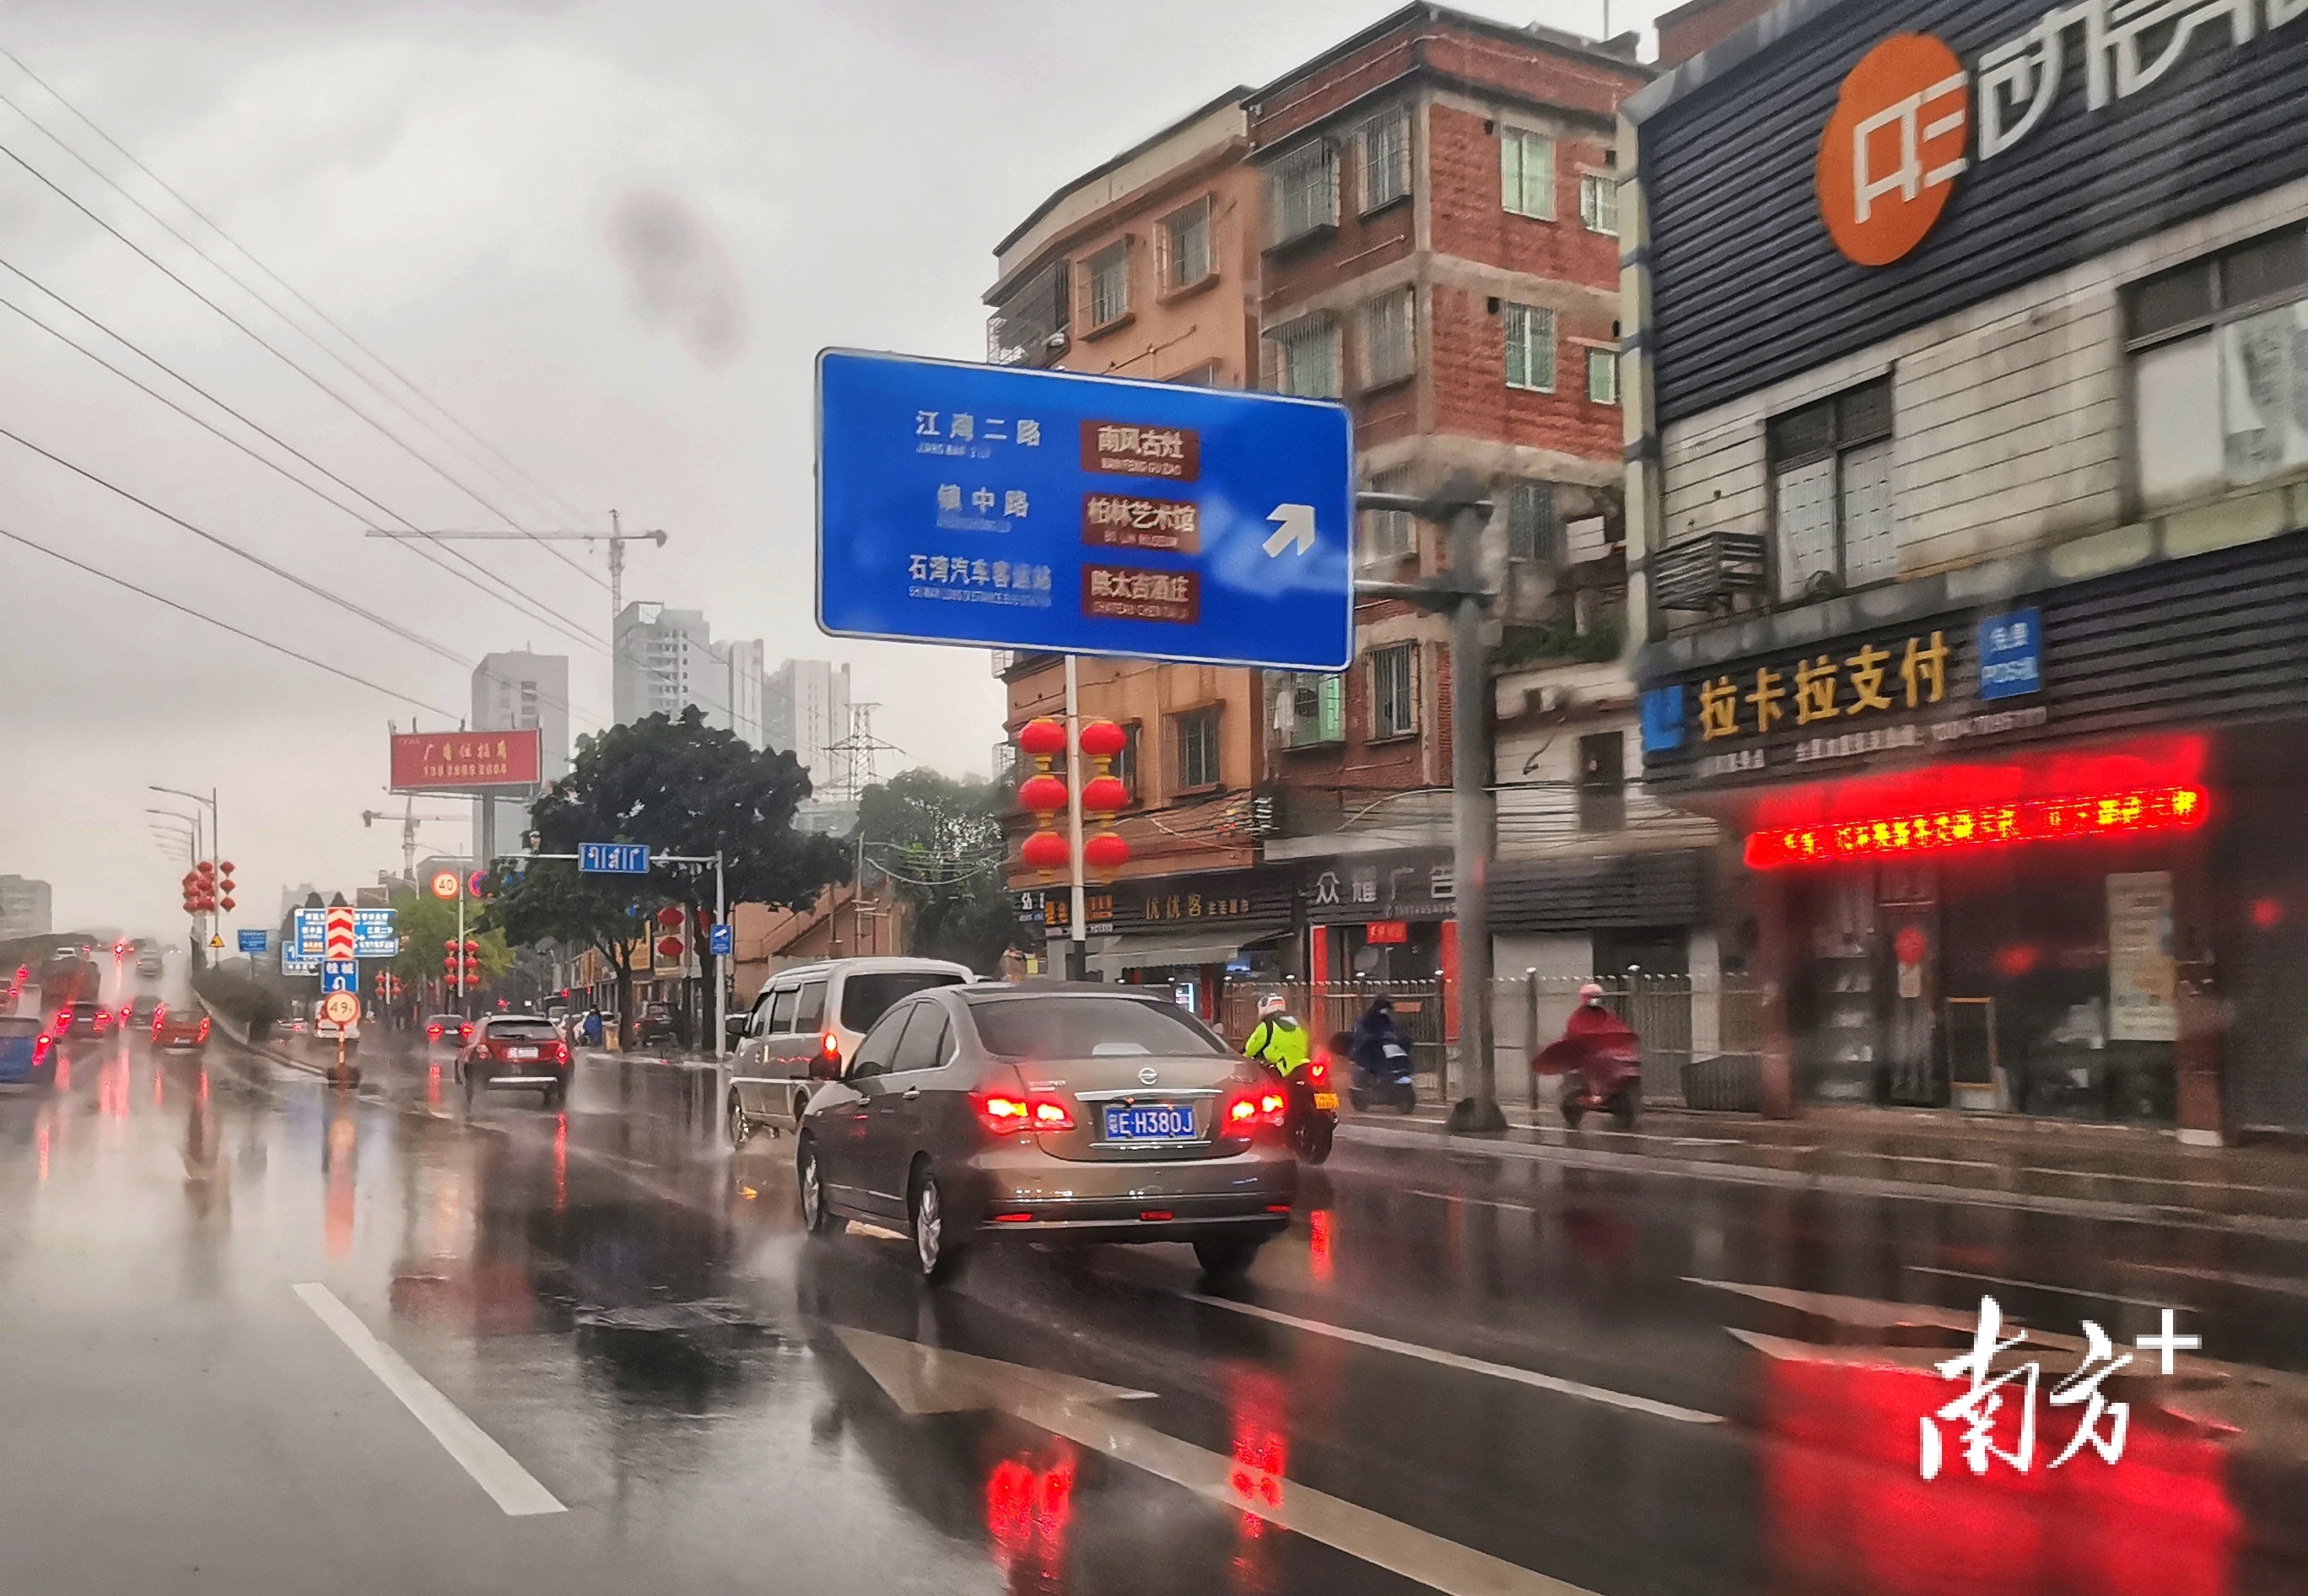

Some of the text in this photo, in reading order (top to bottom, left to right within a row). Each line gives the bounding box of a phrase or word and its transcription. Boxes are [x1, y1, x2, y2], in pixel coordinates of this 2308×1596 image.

[915, 408, 1041, 447] 江湾二路
[1097, 425, 1184, 459] 南风古灶
[1087, 496, 1196, 533] 柏林艺术馆
[1698, 630, 1951, 742] 拉卡拉支付
[439, 878, 454, 891] 40
